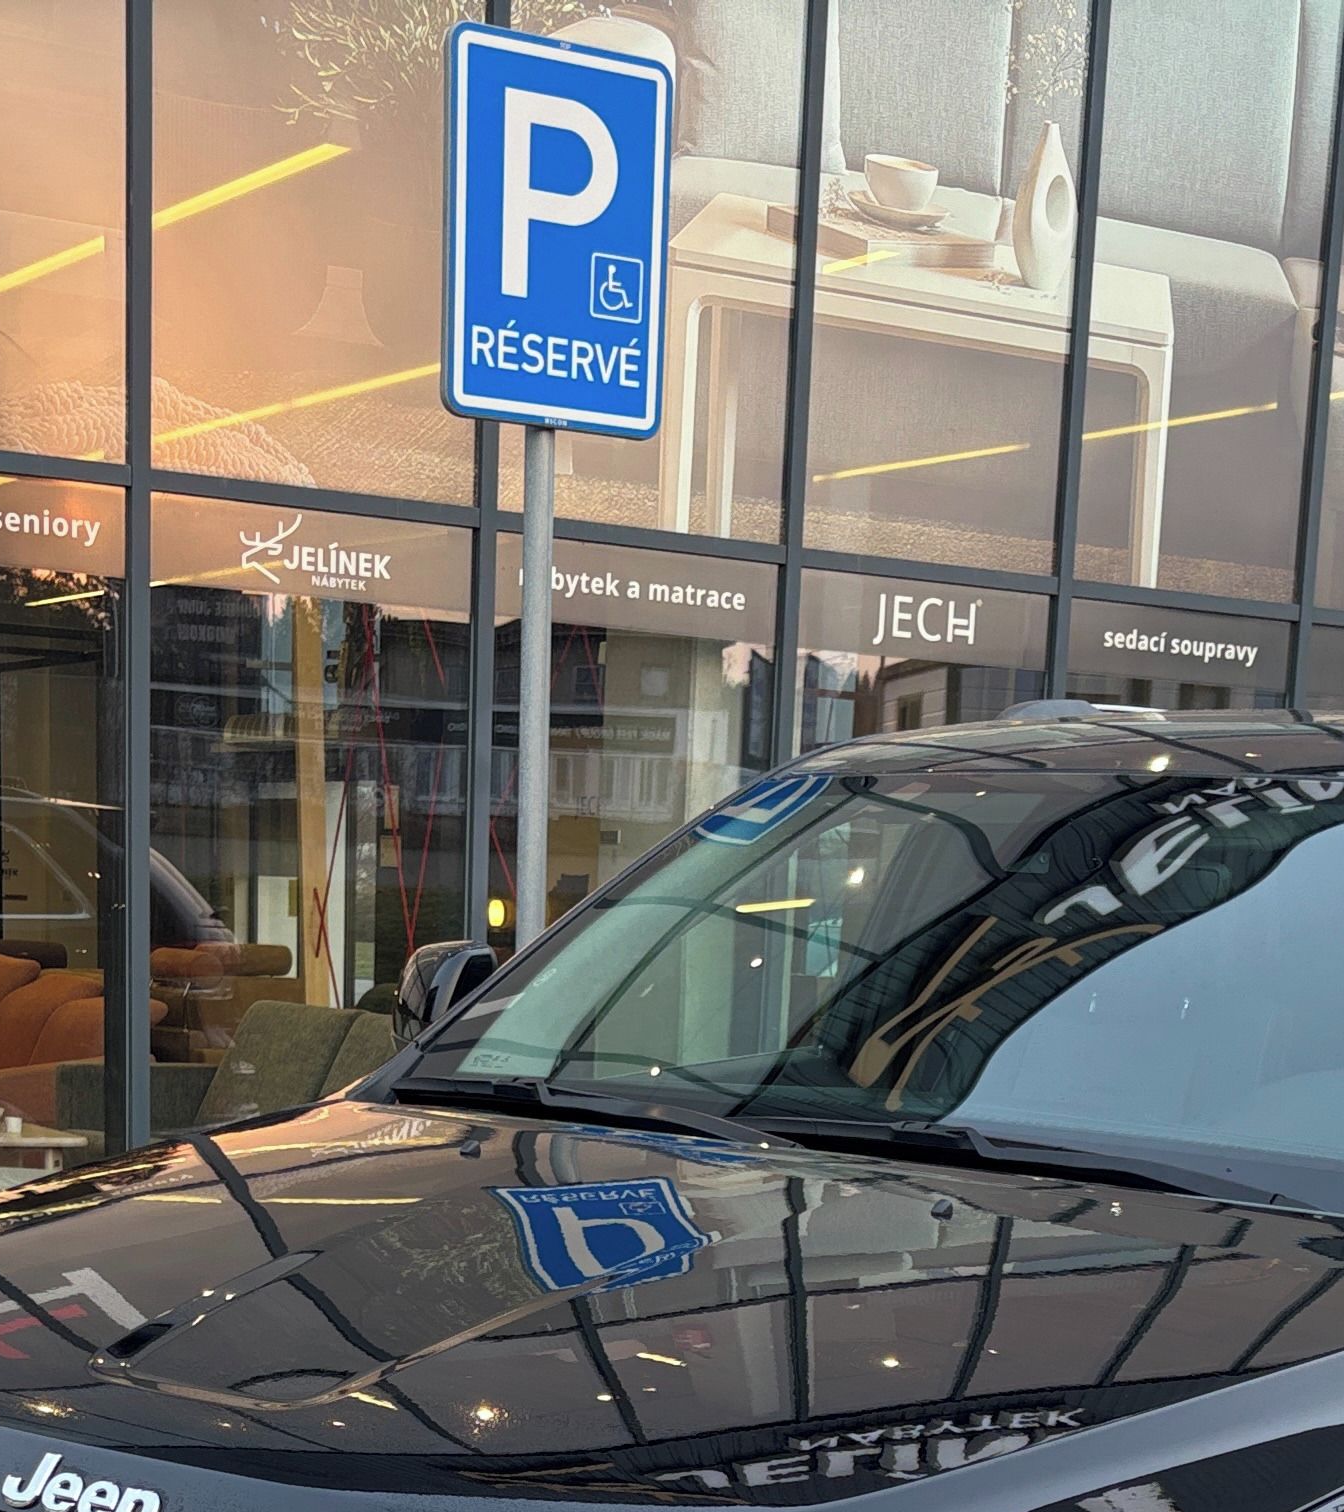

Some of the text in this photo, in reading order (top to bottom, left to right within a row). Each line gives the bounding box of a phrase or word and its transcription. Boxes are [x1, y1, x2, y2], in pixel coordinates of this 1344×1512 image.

[501, 86, 619, 299] P
[471, 319, 642, 389] RÉSERVÉ
[283, 542, 392, 580] JELÍNEK
[311, 575, 367, 592] NÁBYTEK
[518, 565, 747, 611] bytek a matrace
[872, 593, 977, 645] JECH
[1103, 629, 1259, 668] sedací soupravy
